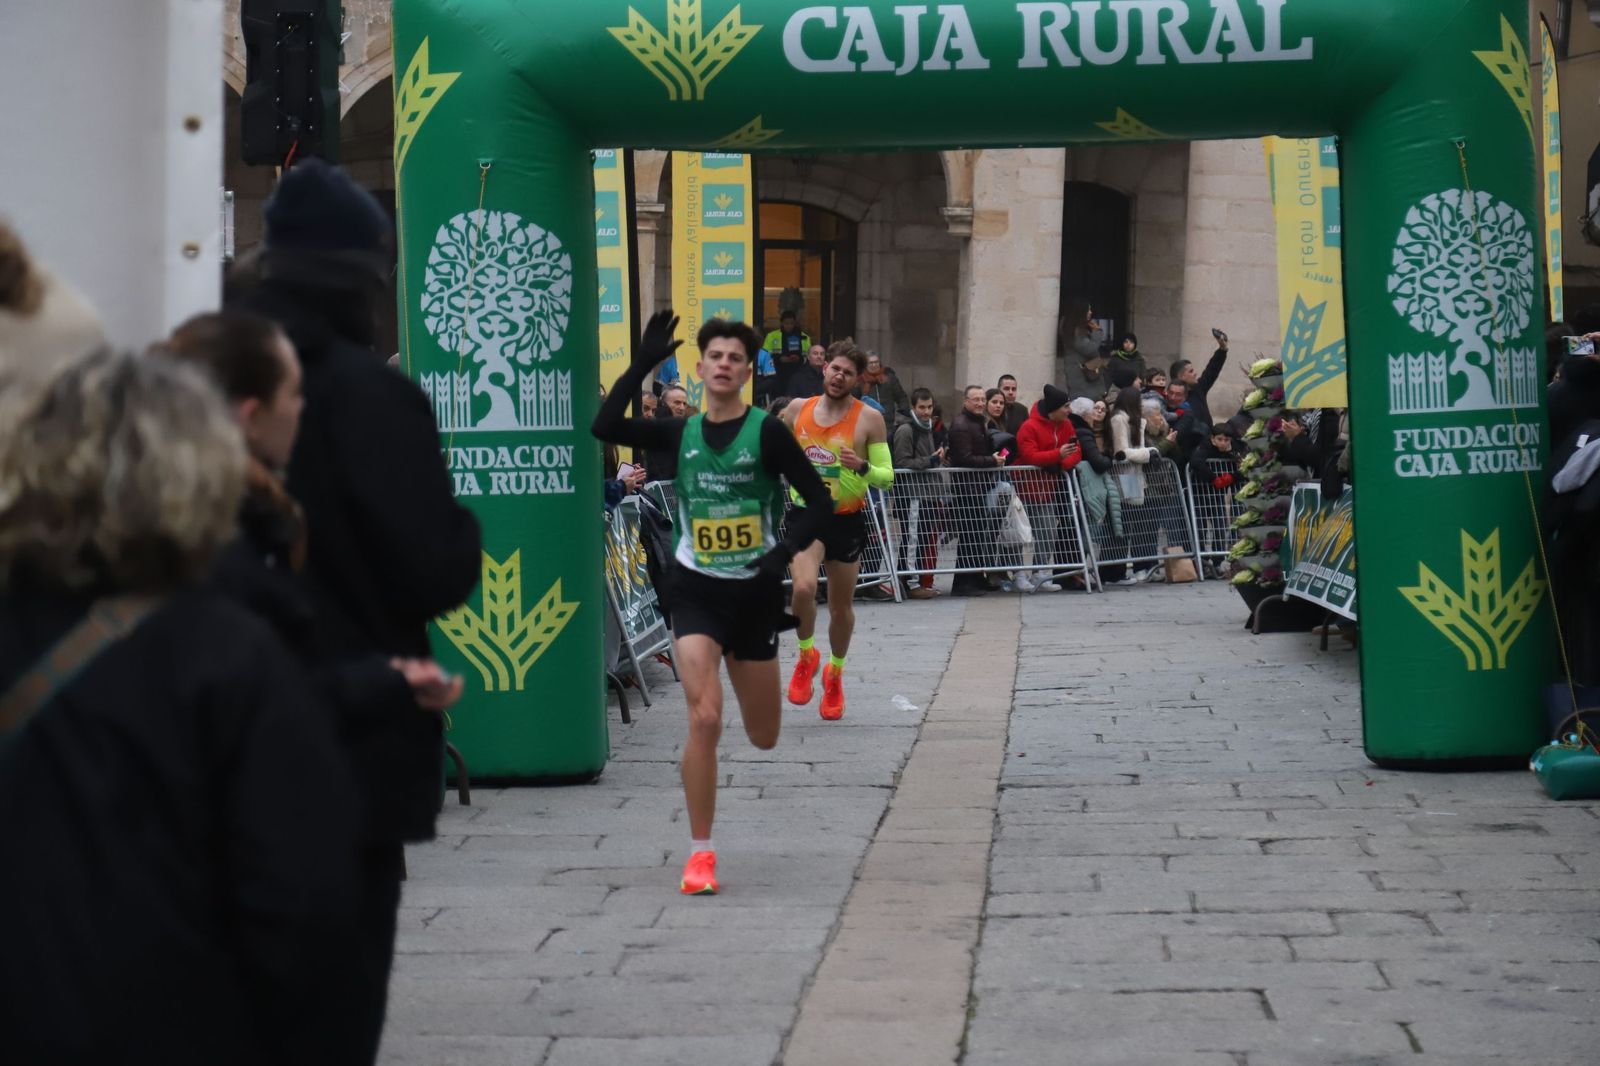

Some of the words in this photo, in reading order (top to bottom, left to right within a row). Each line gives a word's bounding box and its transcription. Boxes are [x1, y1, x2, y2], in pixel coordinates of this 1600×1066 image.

[782, 4, 990, 76] CAJA
[1017, 0, 1314, 68] RURAL
[1393, 423, 1540, 451] FUNDACION
[1394, 452, 1462, 478] CAJA
[1467, 448, 1542, 475] RURAL
[453, 472, 483, 497] JA
[489, 470, 576, 495] RURAL
[697, 523, 753, 551] 695
